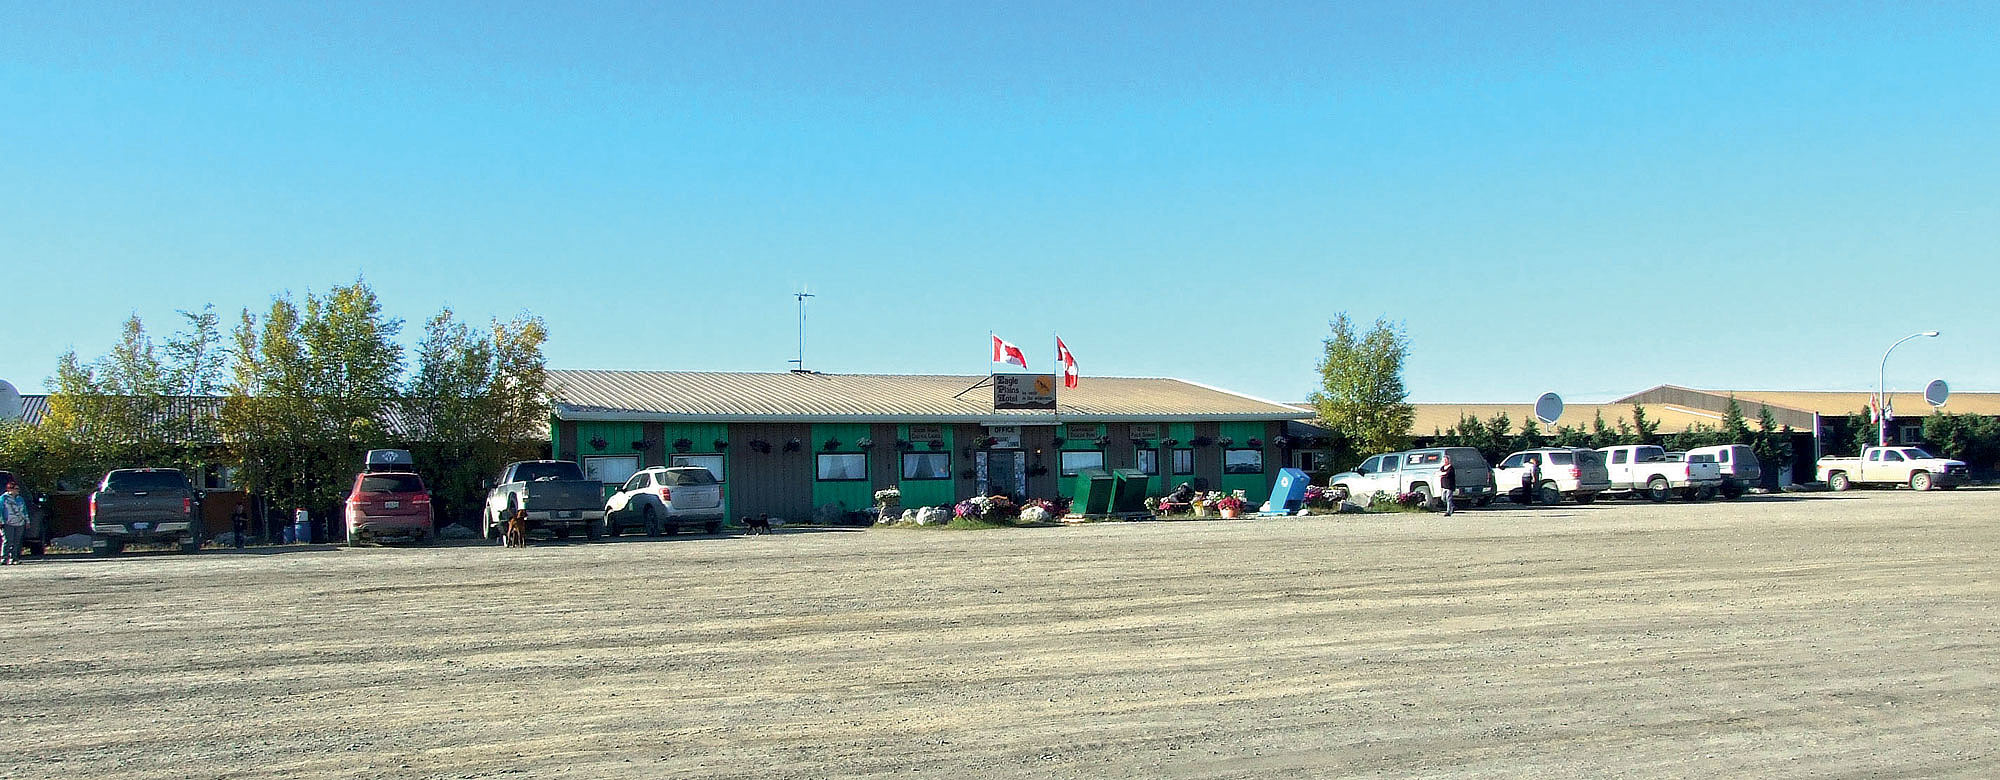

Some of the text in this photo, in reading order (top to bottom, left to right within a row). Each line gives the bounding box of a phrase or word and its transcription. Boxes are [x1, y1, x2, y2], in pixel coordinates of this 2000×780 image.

[997, 376, 1018, 386] Eagle
[997, 385, 1019, 393] Plains
[997, 394, 1018, 402] Hotel
